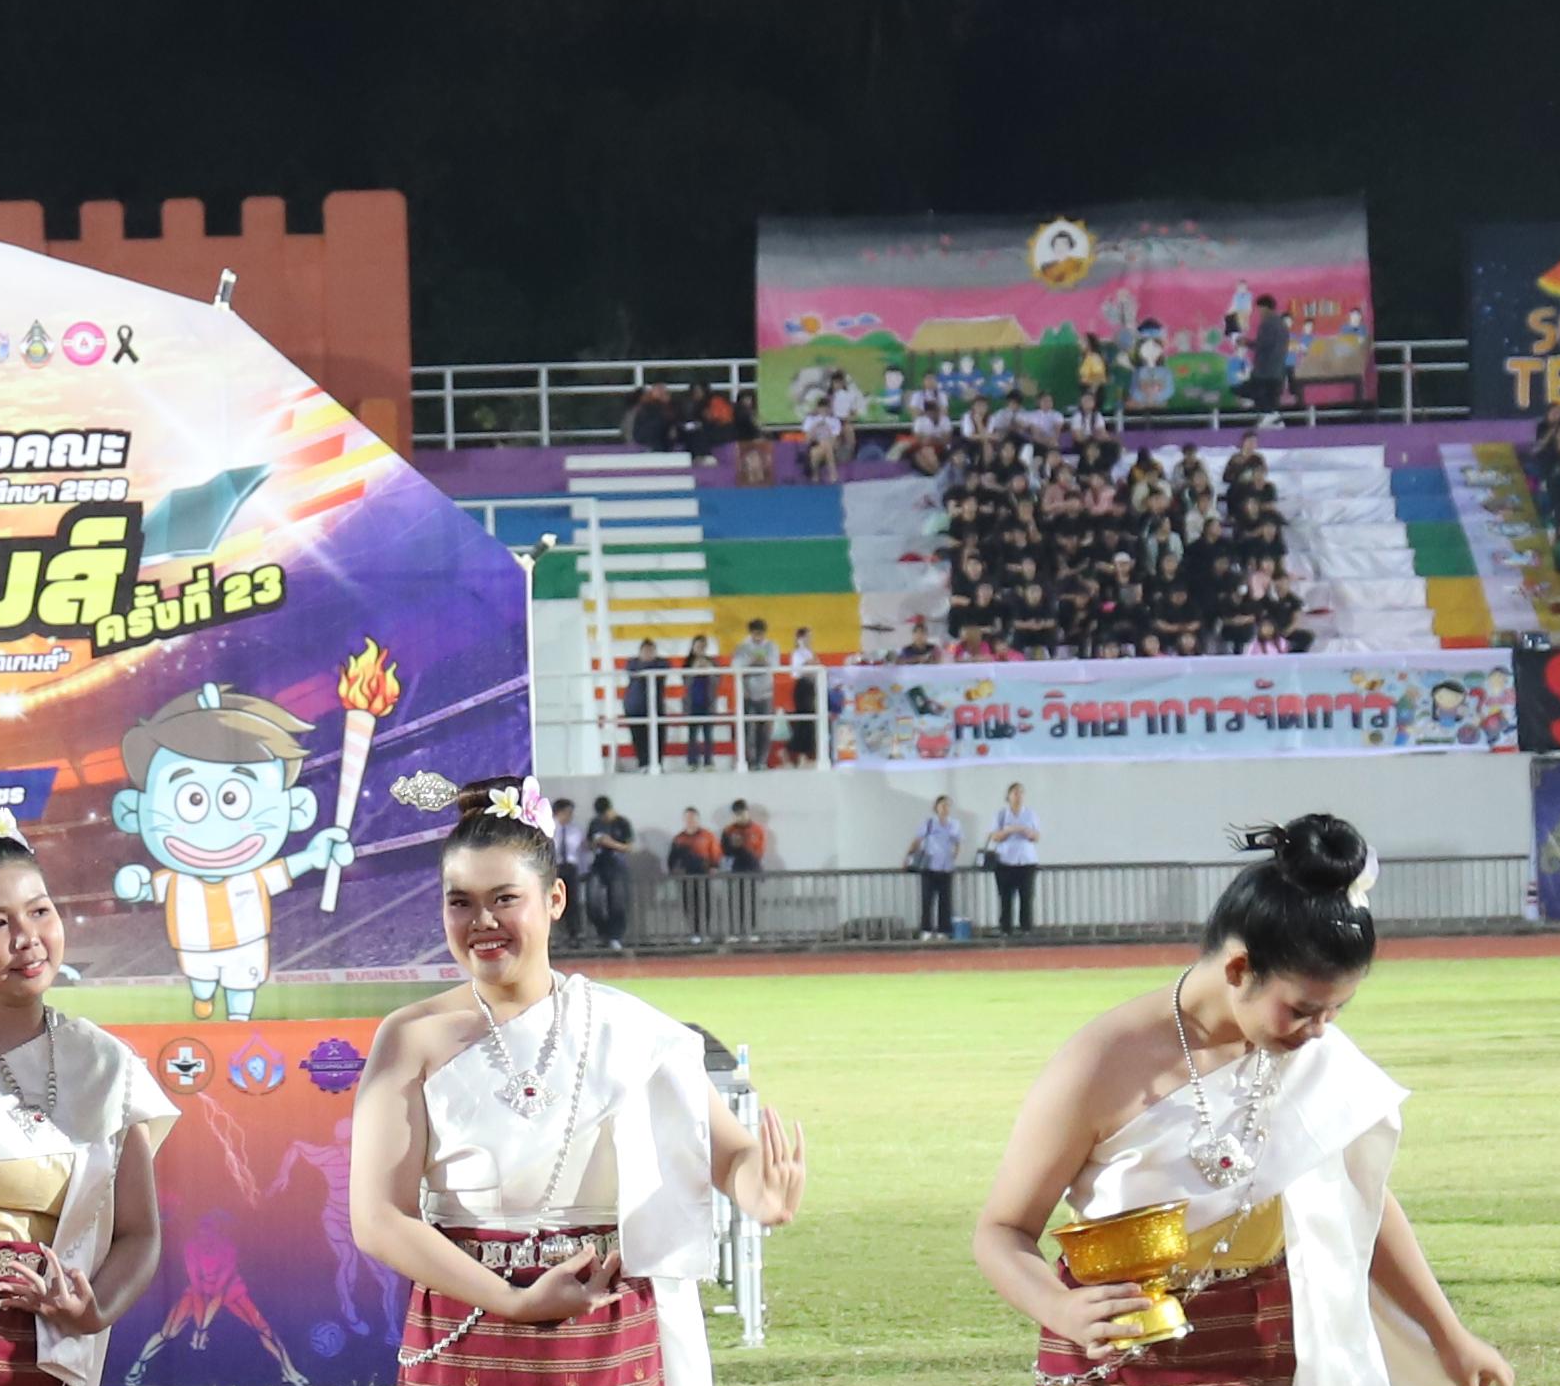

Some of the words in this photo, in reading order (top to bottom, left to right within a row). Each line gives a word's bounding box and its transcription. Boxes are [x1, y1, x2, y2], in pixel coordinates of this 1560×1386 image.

[93, 564, 215, 651] ครั้งที่
[222, 565, 284, 616] 23
[345, 967, 421, 982] BUSINESS
